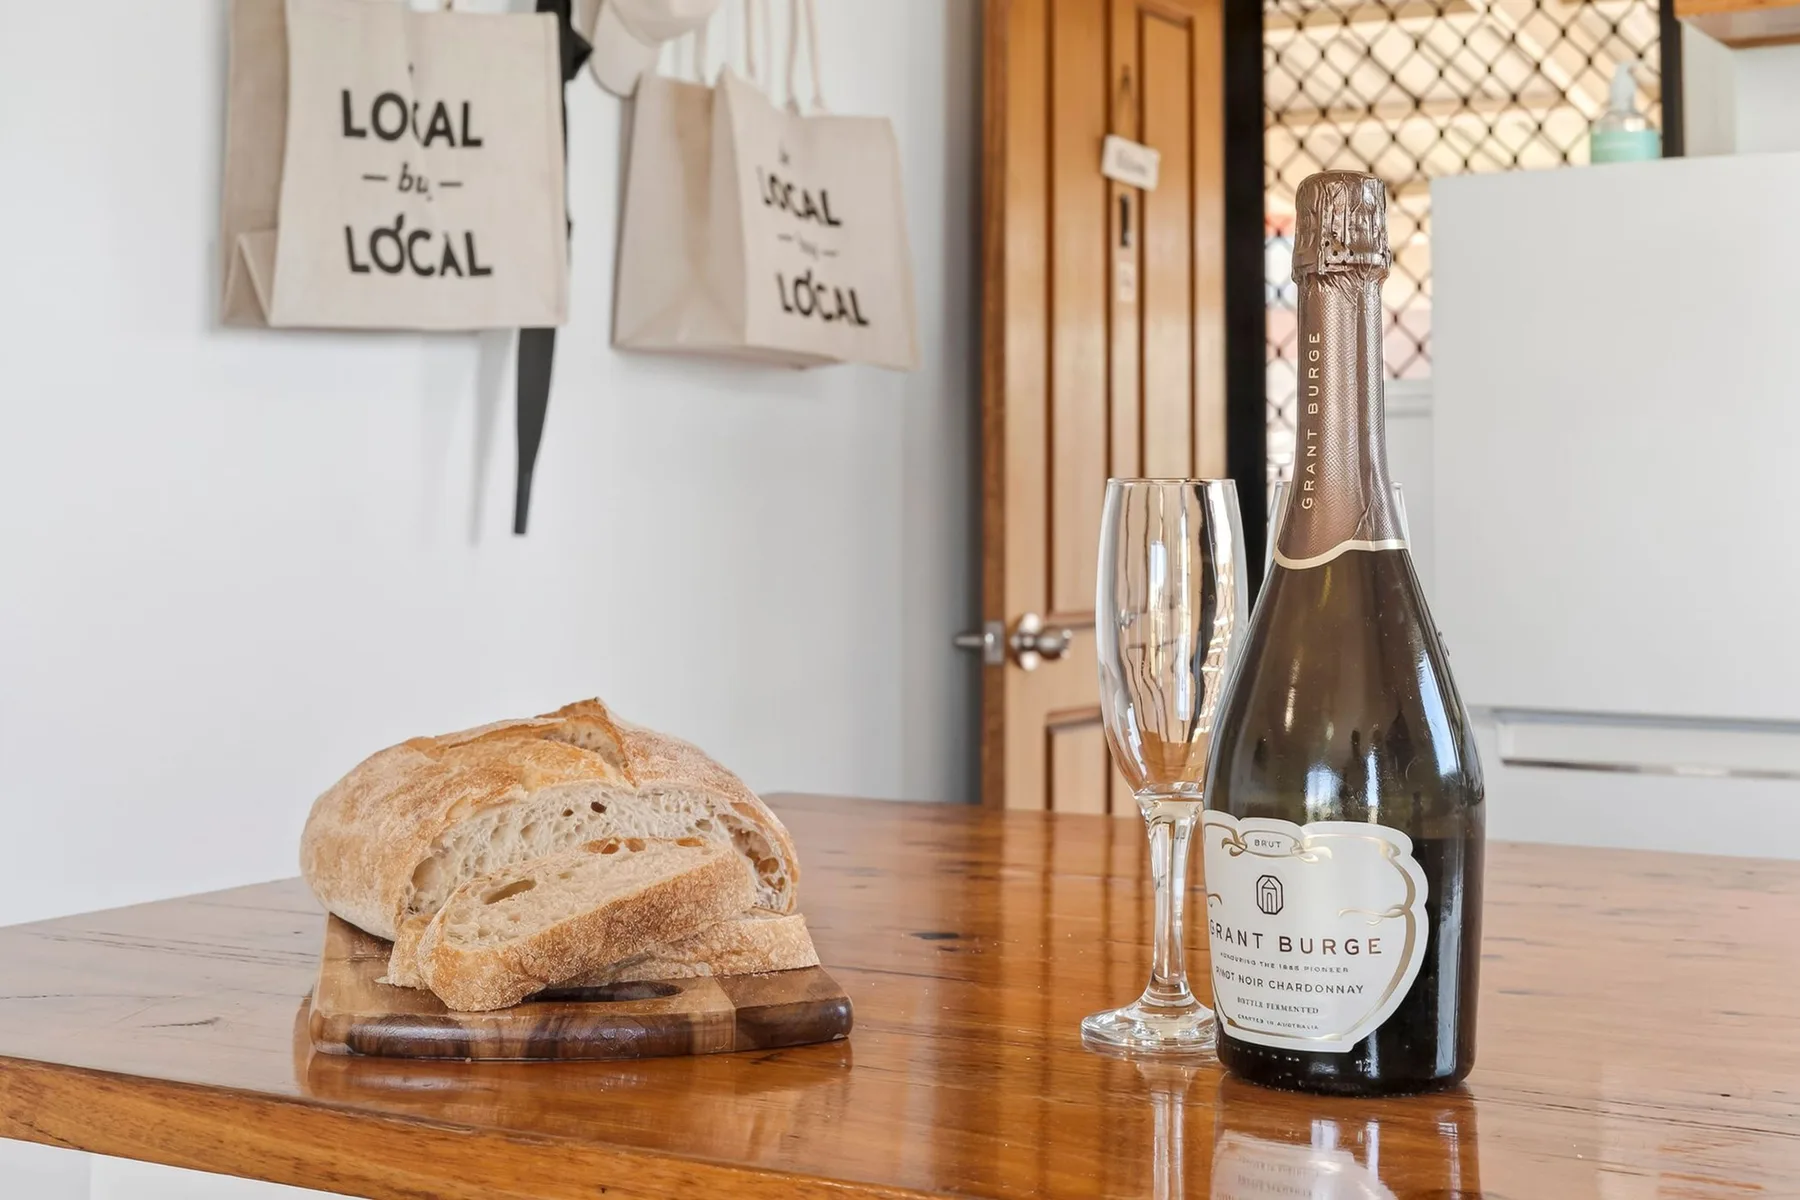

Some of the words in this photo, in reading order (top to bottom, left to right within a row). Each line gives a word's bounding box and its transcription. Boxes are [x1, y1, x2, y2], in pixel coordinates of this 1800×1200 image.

[756, 165, 842, 227] LOCAL
[345, 212, 493, 277] LOCAL
[775, 268, 869, 327] LOCAL
[1308, 332, 1321, 415] BURGE
[1301, 428, 1318, 510] GRANT
[1254, 838, 1281, 848] BRUT
[1259, 961, 1275, 969] THE
[1279, 935, 1382, 956] BURGE
[1238, 974, 1264, 988] NOIR
[1268, 980, 1364, 995] CHARDONNAY
[1266, 1002, 1319, 1014] FERMENTED
